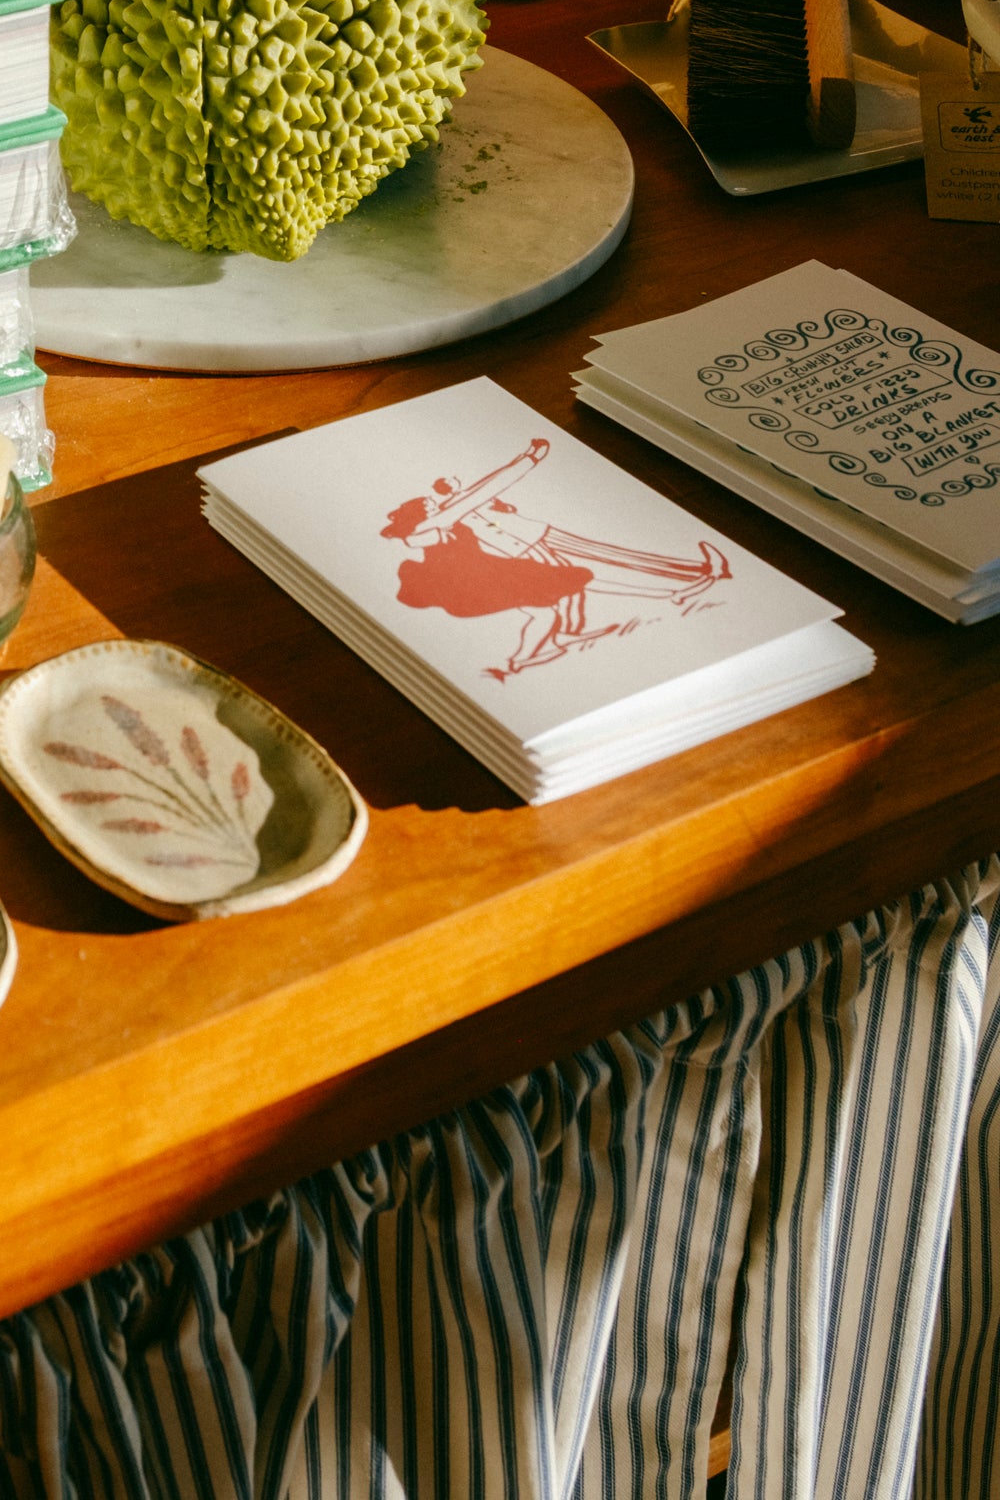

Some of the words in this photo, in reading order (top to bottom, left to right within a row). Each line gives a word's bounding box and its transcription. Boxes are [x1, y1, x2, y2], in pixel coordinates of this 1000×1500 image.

[951, 124, 988, 134] earth
[964, 134, 994, 143] nest
[751, 373, 782, 396] BIG
[835, 333, 875, 357] SALAD
[784, 376, 821, 397] FRESH
[832, 359, 858, 376] CUT
[793, 360, 885, 404] FLOWERS
[804, 393, 855, 416] COLD
[863, 369, 921, 394] FIZZY
[833, 385, 918, 423] DRINKS
[853, 411, 901, 435] SEEDY
[900, 391, 952, 416] BREADS
[869, 442, 913, 463] BIG
[915, 401, 1000, 444] BLANKET
[882, 423, 914, 441] ON
[922, 411, 938, 424] A
[914, 444, 960, 469] WITH
